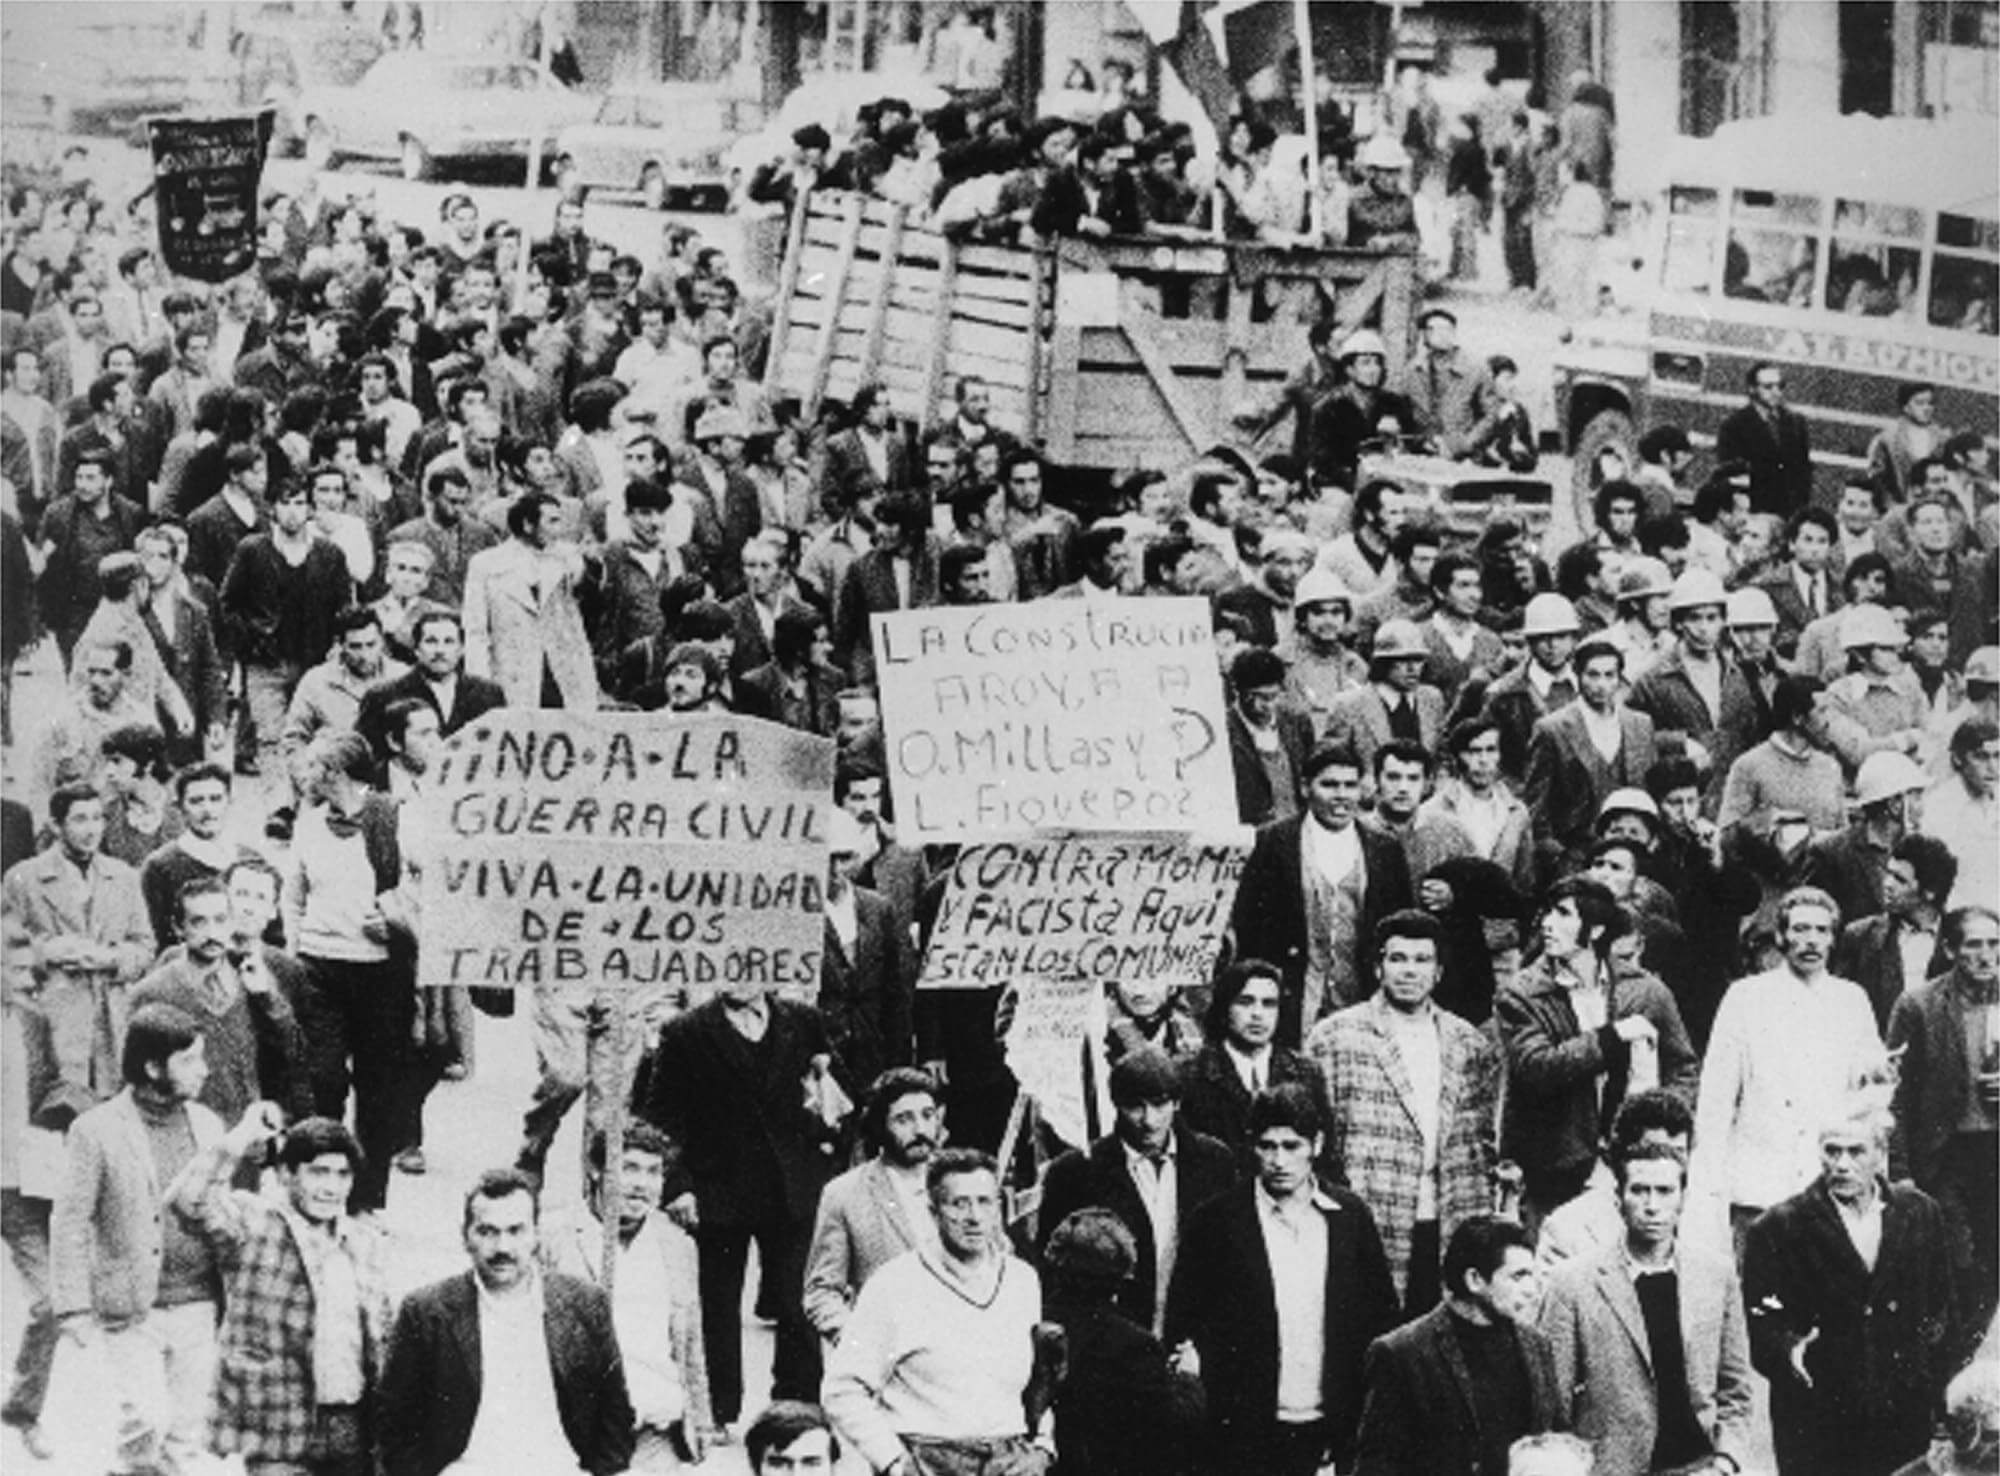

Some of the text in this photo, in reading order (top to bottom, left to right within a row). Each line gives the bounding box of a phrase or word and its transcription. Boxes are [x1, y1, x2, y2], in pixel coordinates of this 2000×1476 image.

[450, 792, 829, 844] GUERRA CIVIL
[443, 856, 825, 913] VIVA LA UNIDAD
[522, 906, 726, 944] DE LOS
[448, 947, 822, 984] TRABAJADORES
